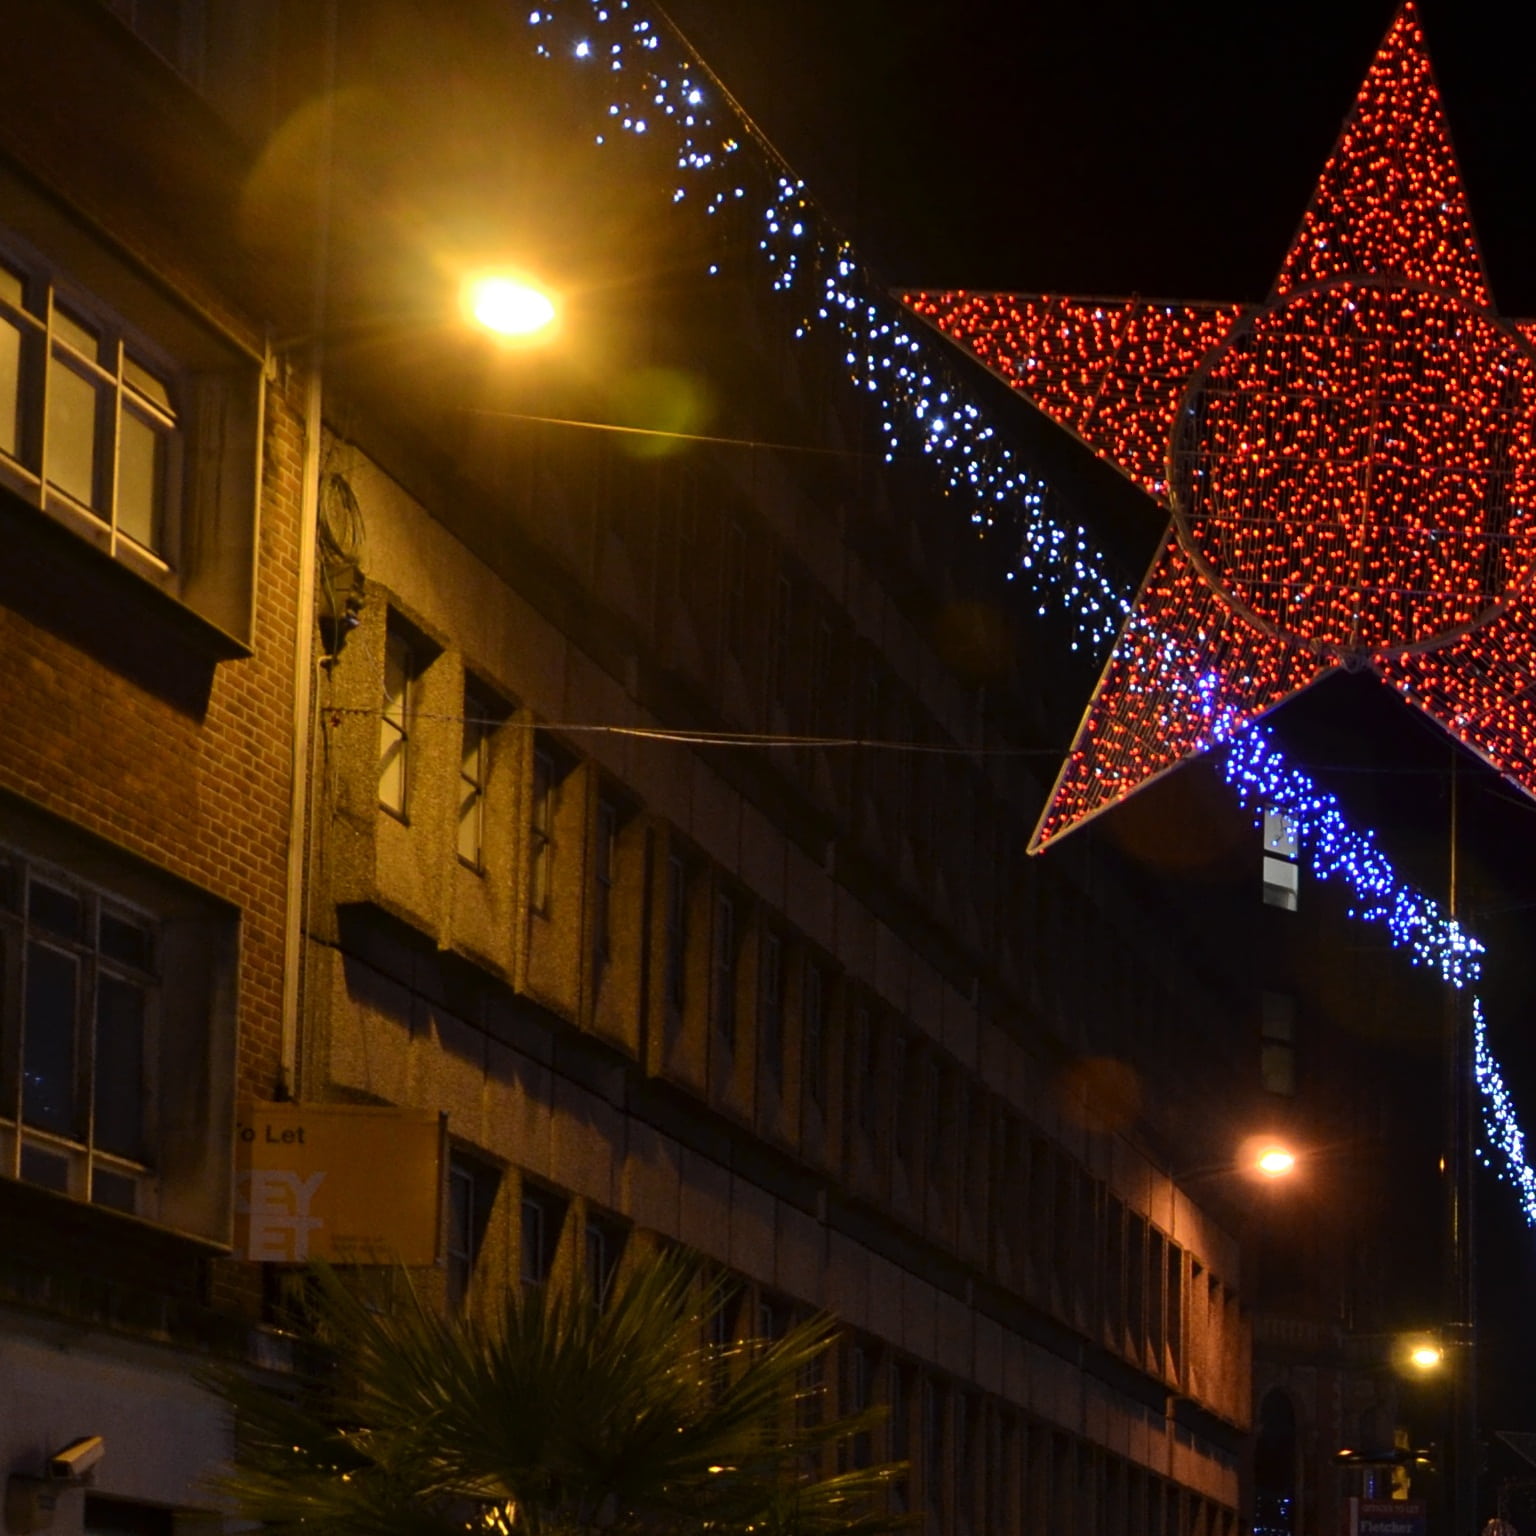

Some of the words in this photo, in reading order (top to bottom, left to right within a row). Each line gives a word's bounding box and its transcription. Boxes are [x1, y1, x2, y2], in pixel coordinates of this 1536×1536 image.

[236, 1122, 255, 1143] o
[265, 1125, 305, 1144] Let
[1360, 1520, 1414, 1533] Fletcher
